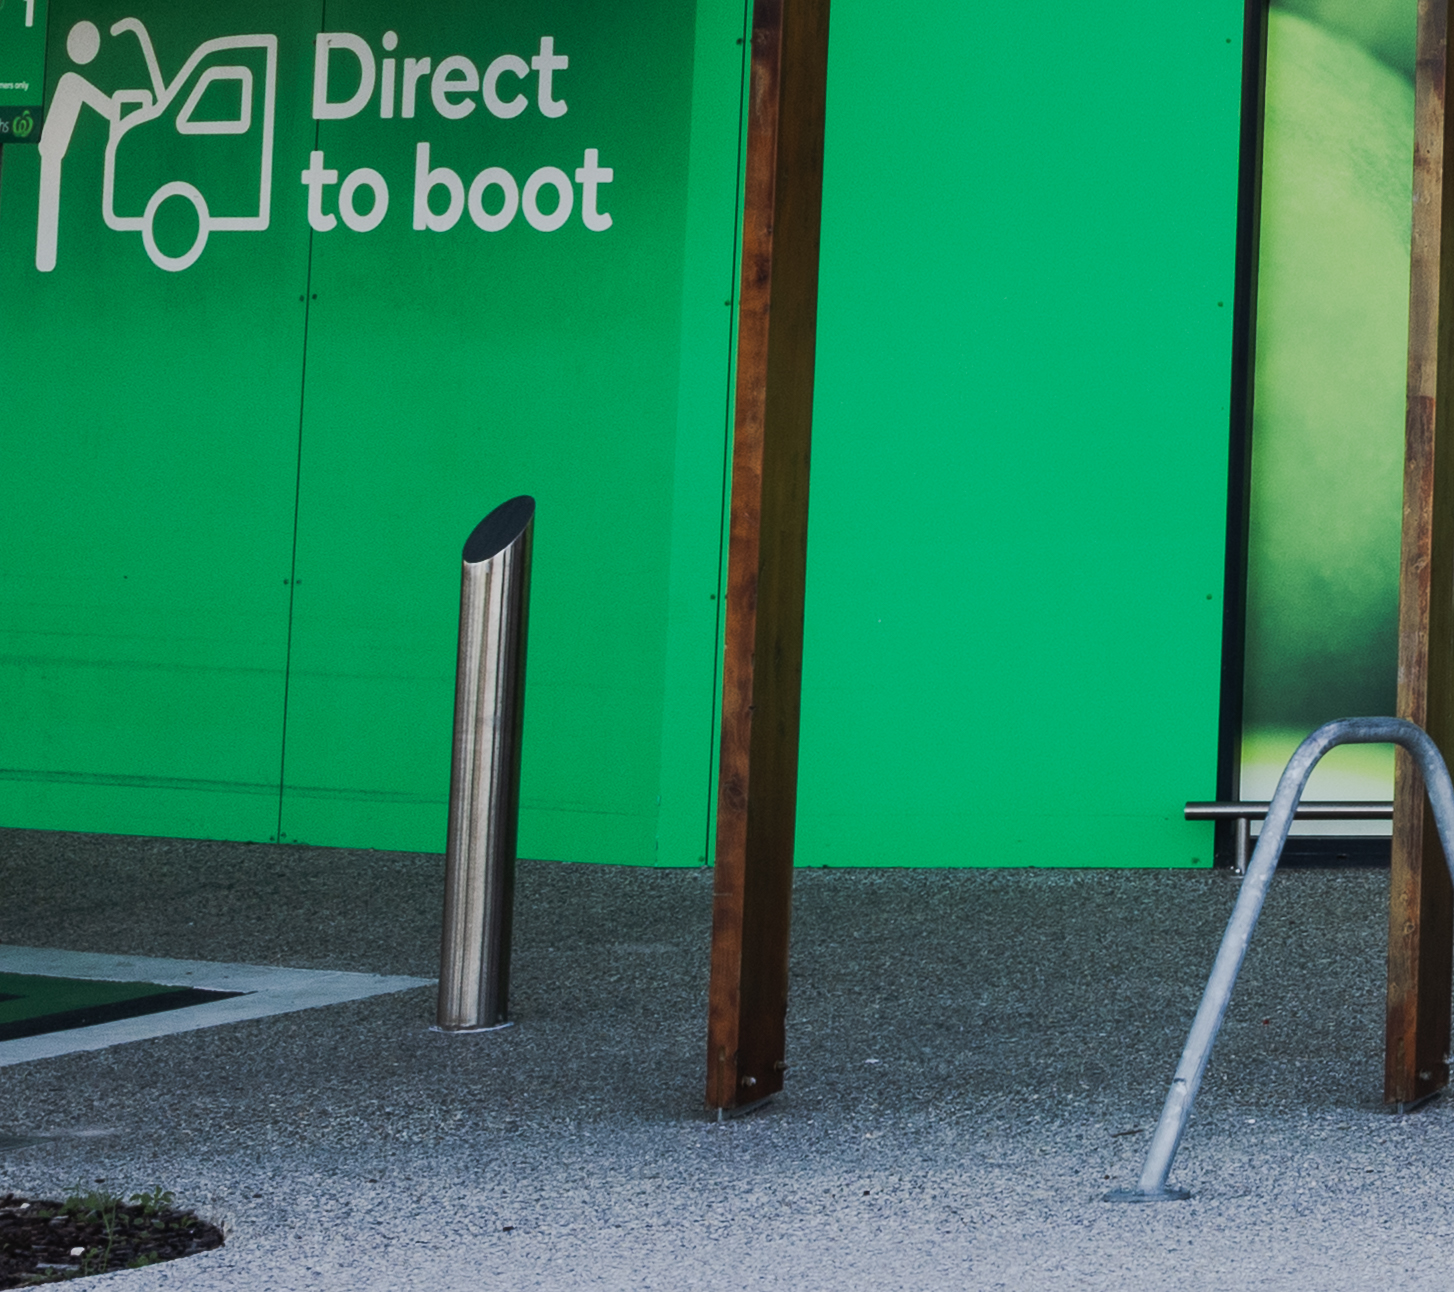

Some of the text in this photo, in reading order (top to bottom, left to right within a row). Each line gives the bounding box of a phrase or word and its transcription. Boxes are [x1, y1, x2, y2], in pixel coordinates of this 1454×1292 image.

[312, 30, 569, 120] Direct
[301, 141, 614, 233] to boot
